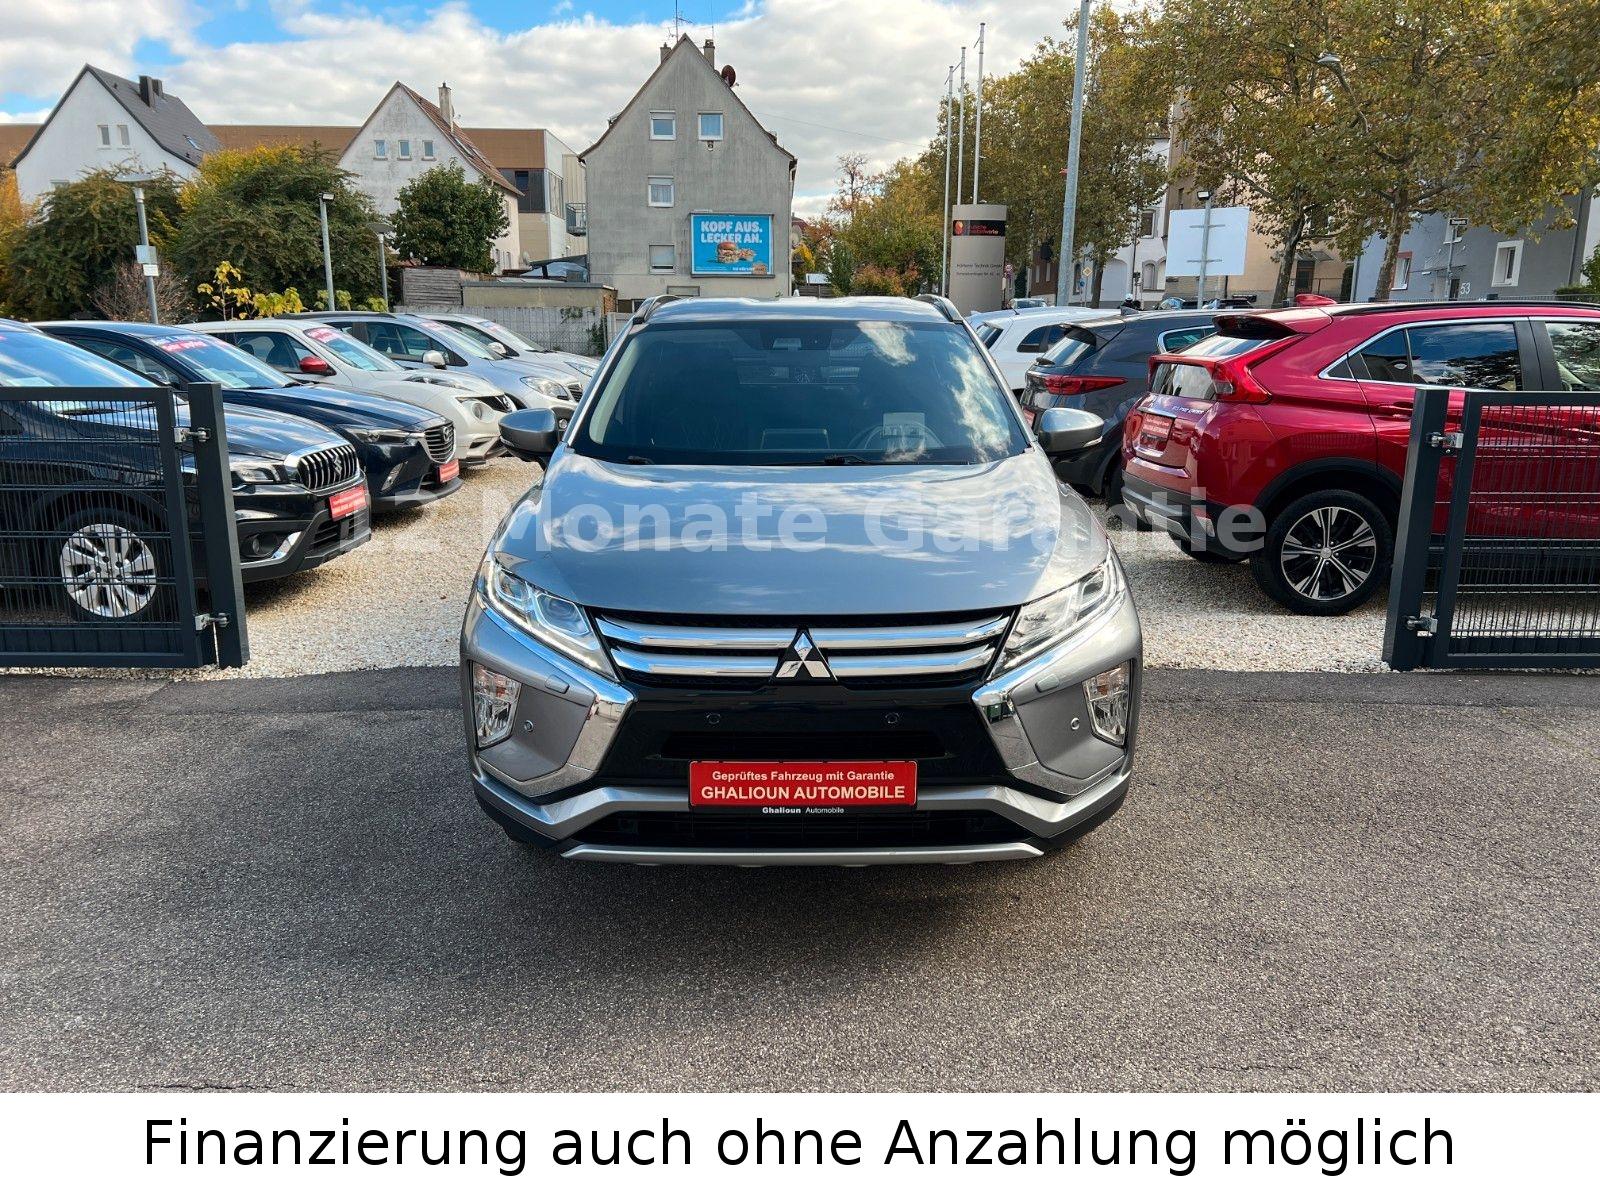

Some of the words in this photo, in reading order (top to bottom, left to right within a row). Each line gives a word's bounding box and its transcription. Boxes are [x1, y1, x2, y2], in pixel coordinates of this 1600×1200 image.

[701, 221, 733, 233] KOPF
[734, 221, 763, 233] AUS.
[700, 232, 742, 244] LECKER
[743, 232, 763, 244] AN.
[1460, 282, 1471, 295] 53
[712, 770, 768, 783] Geprüftes
[770, 770, 823, 783] Fahrzeug
[825, 770, 844, 781] mit
[846, 770, 895, 781] Garantie
[701, 786, 791, 800] GHALIOUN
[793, 785, 906, 800] AUTOMOBILE
[762, 806, 802, 814] Ghalioun
[805, 806, 845, 814] Automobile
